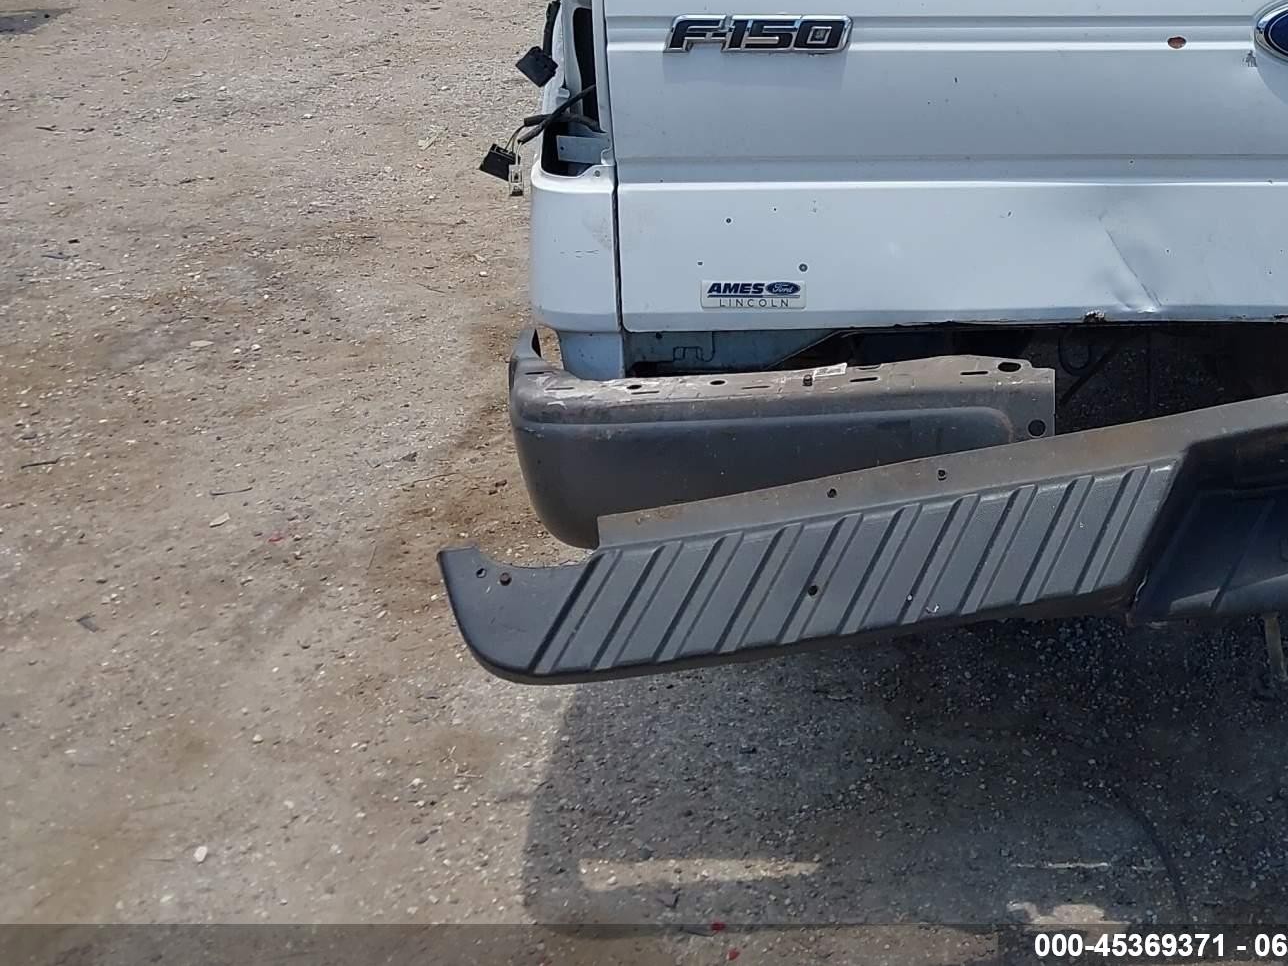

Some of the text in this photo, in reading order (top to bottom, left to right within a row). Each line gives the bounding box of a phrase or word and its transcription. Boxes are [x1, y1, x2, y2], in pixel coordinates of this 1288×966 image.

[663, 14, 854, 53] F-150
[707, 282, 765, 294] AMES
[719, 298, 789, 308] LINCOLN
